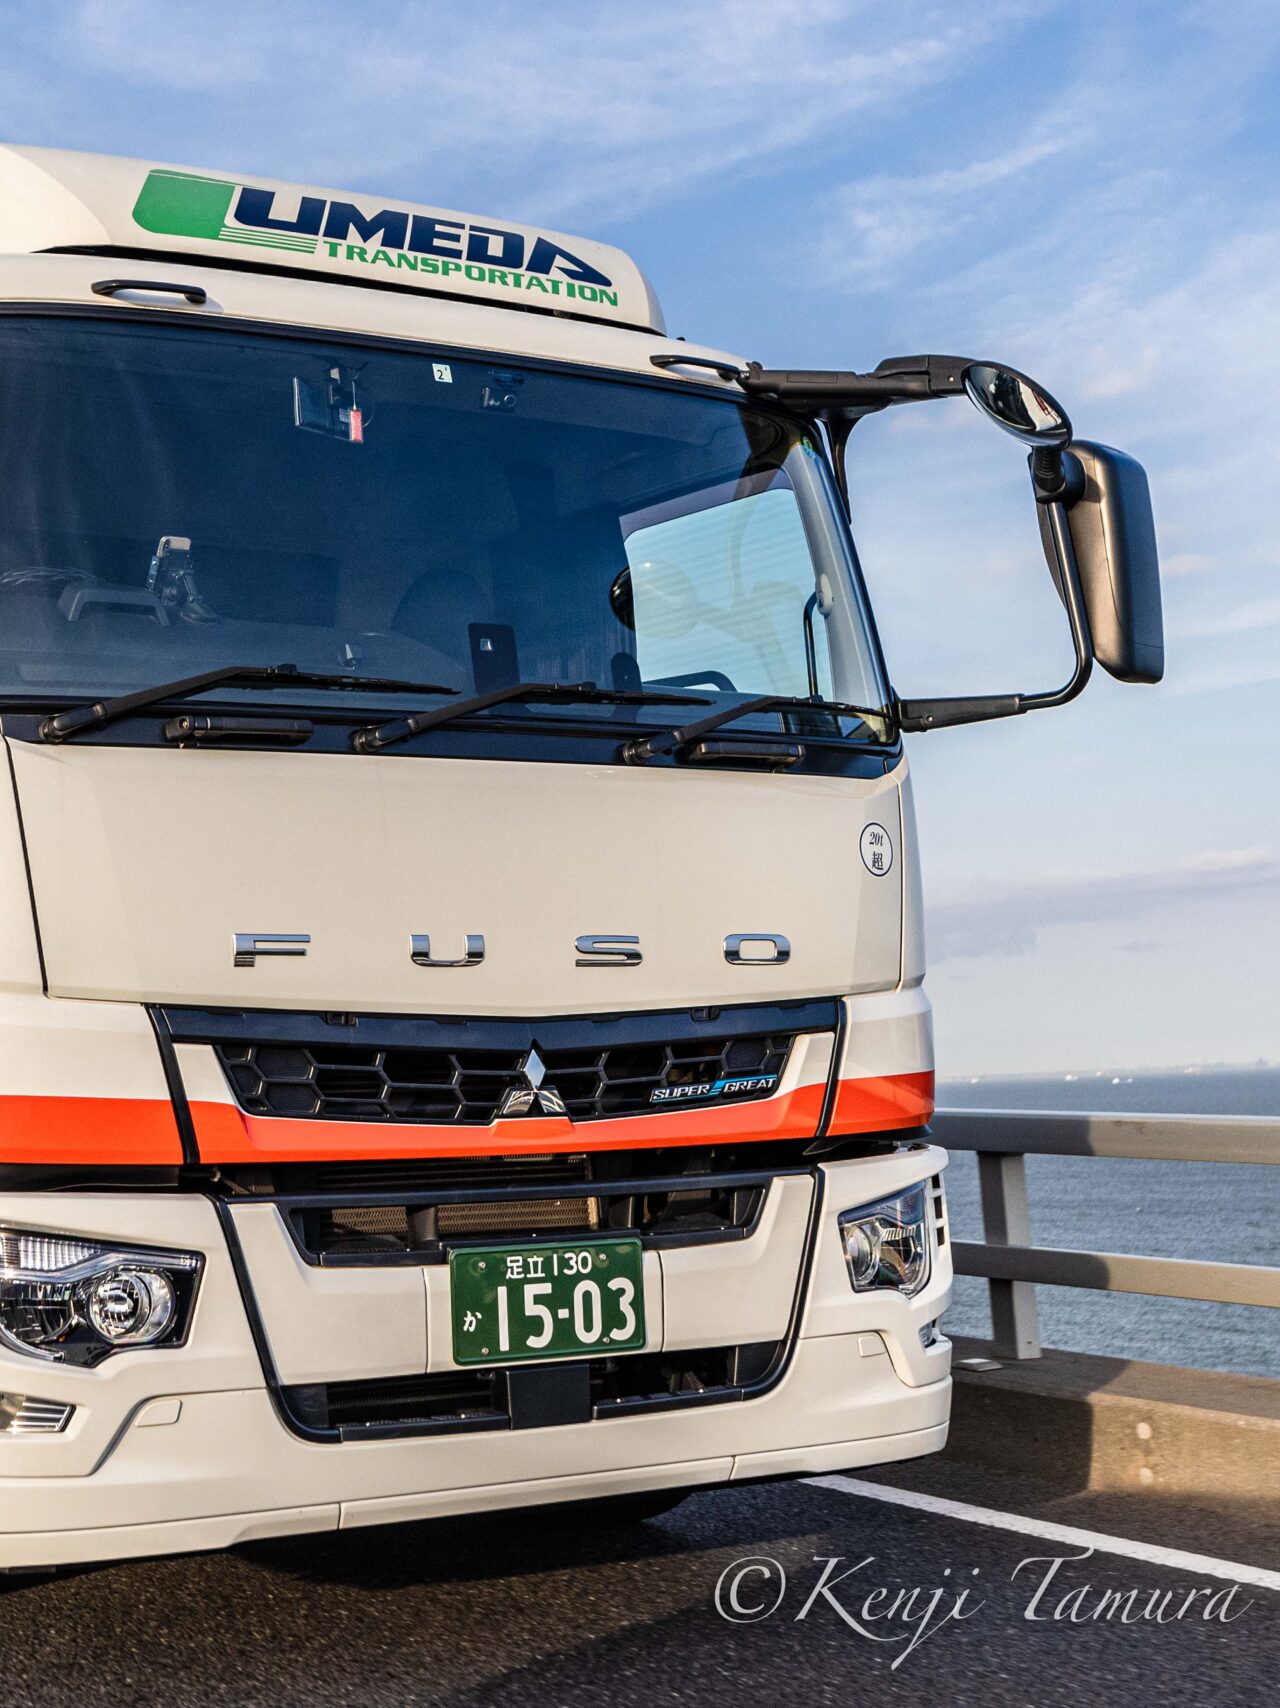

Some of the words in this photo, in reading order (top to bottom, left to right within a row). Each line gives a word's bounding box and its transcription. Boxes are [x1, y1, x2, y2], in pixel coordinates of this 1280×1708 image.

[234, 187, 613, 288] UMEDA
[323, 240, 618, 307] TRANSPORTATION
[869, 832, 883, 847] 20t
[232, 933, 791, 967] FUSO
[653, 1084, 710, 1100] SUPER
[724, 1078, 777, 1094] GREAT
[506, 1256, 545, 1280] 足立
[553, 1251, 593, 1276] 130
[462, 1310, 482, 1333] か
[497, 1277, 636, 1352] 15-03
